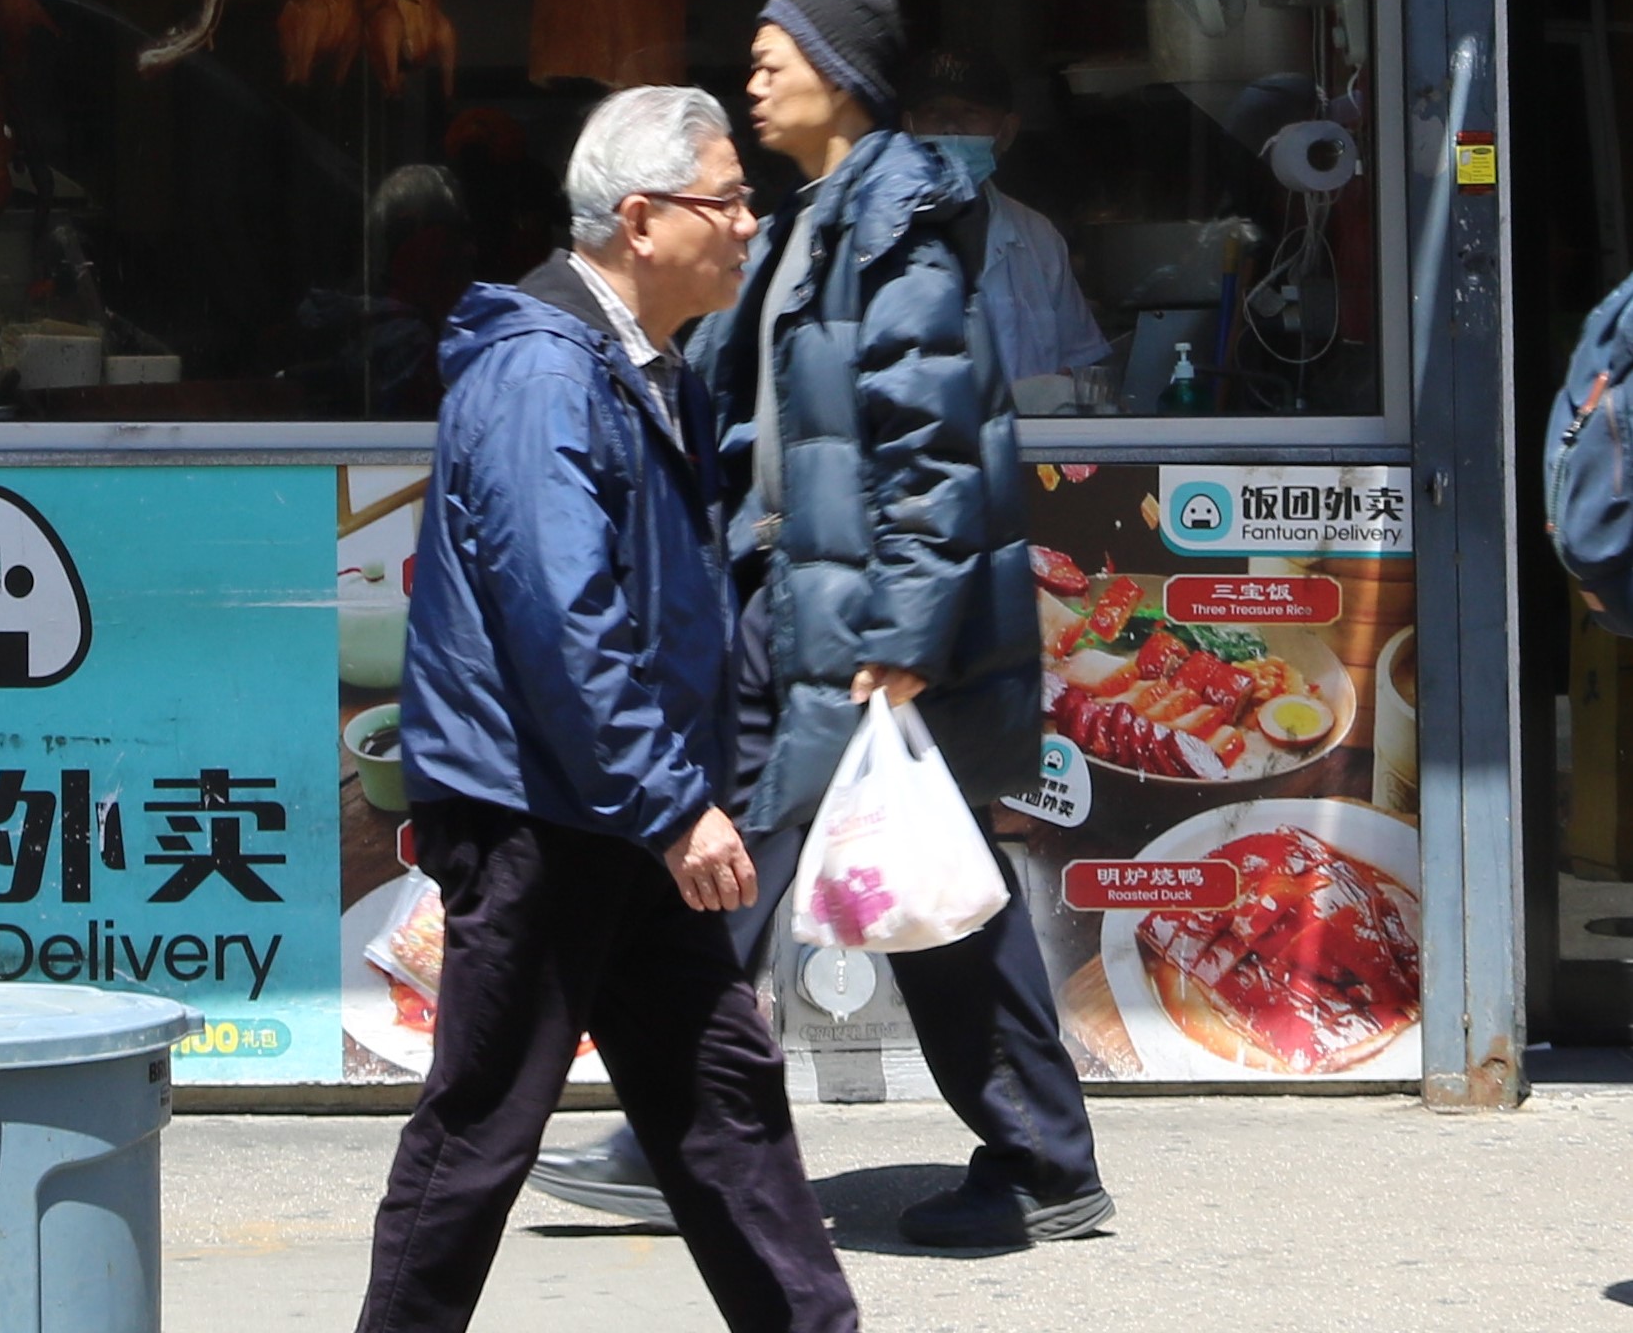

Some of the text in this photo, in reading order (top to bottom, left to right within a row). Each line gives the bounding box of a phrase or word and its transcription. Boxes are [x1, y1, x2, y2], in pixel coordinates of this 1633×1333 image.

[1240, 485, 1405, 522] 饭团外卖
[1242, 524, 1403, 546] Fantuan Delivery
[1211, 582, 1293, 602] 三宝饭
[1191, 604, 1313, 616] Three Treasure Rice
[1014, 791, 1075, 819] 团外卖
[1096, 867, 1205, 887] 明炉烧鸭
[1108, 889, 1192, 901] Roasted Duck
